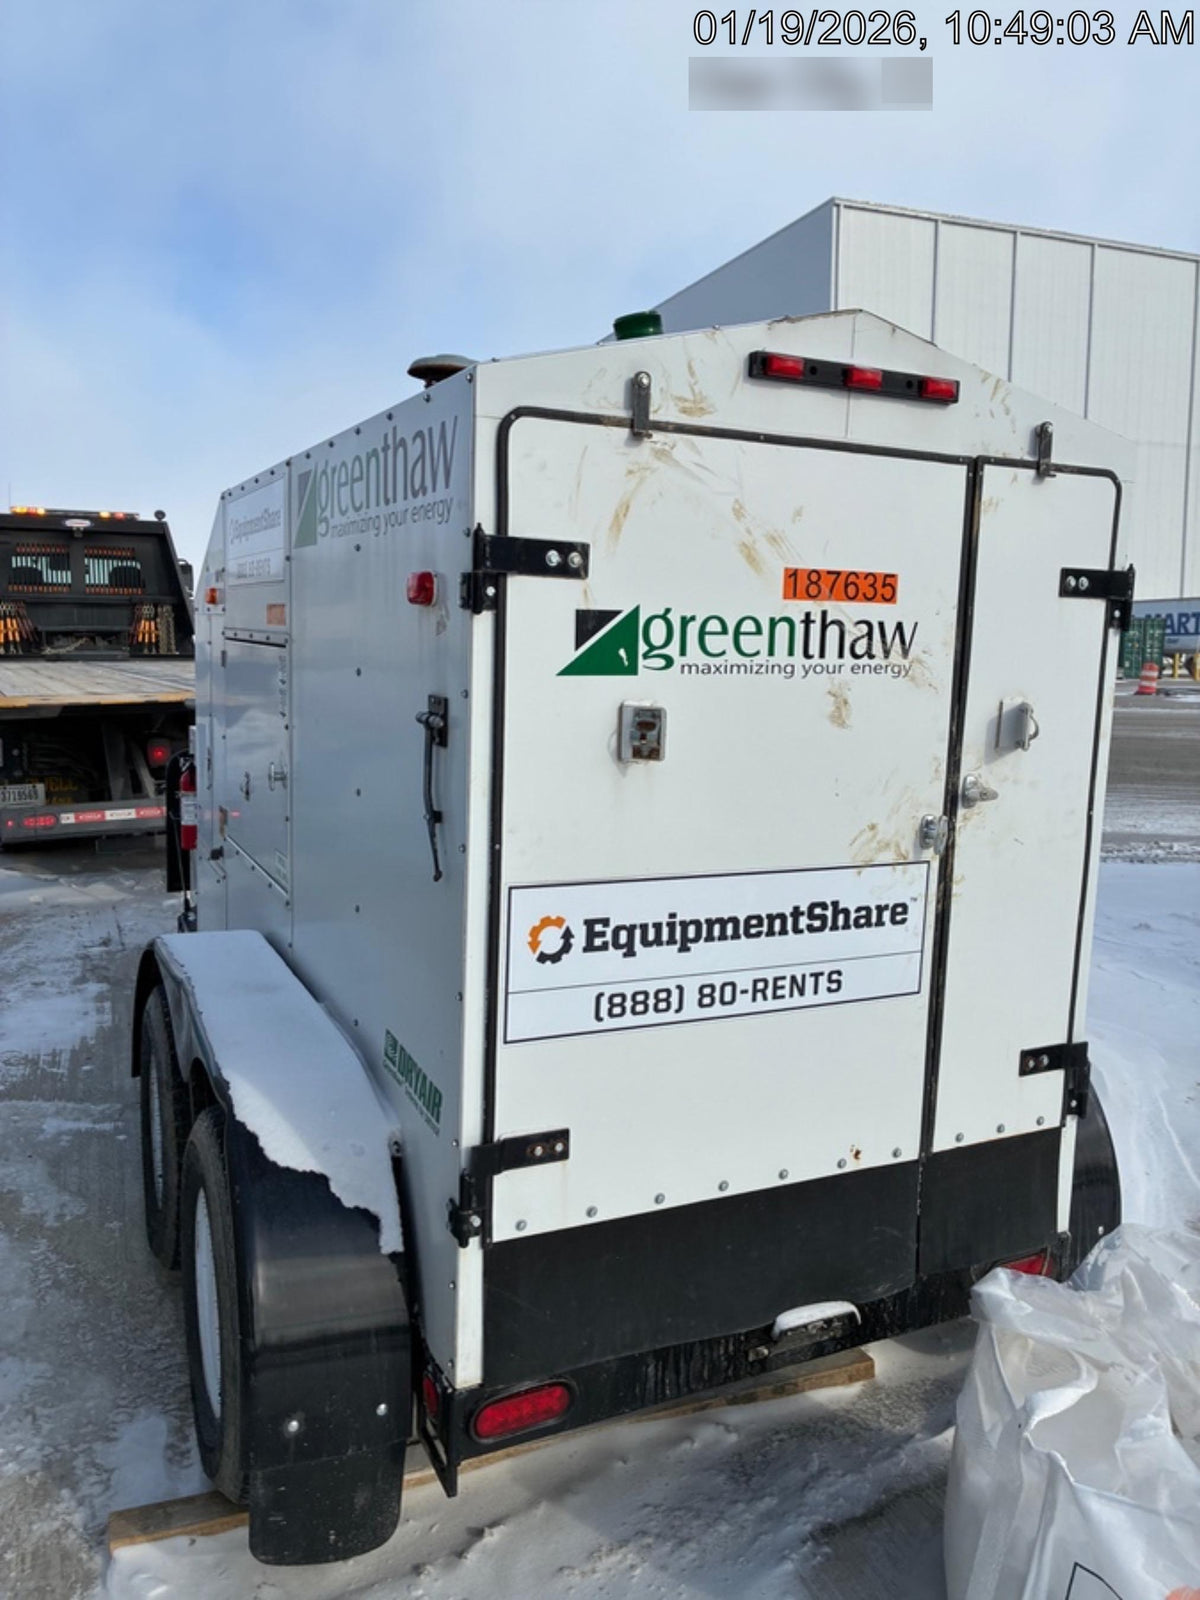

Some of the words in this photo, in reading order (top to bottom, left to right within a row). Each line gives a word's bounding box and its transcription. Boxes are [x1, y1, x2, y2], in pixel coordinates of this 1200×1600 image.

[318, 415, 458, 538] greenthaw
[383, 508, 409, 536] your
[411, 498, 454, 526] energy
[786, 572, 897, 602] 187635
[641, 606, 919, 671] greenthaw
[680, 659, 796, 679] maximizing
[801, 662, 845, 679] your
[850, 662, 913, 679] energy
[582, 899, 910, 958] EquipmentShare
[594, 984, 685, 1023] (888)
[697, 969, 844, 1010] 80-RENTS
